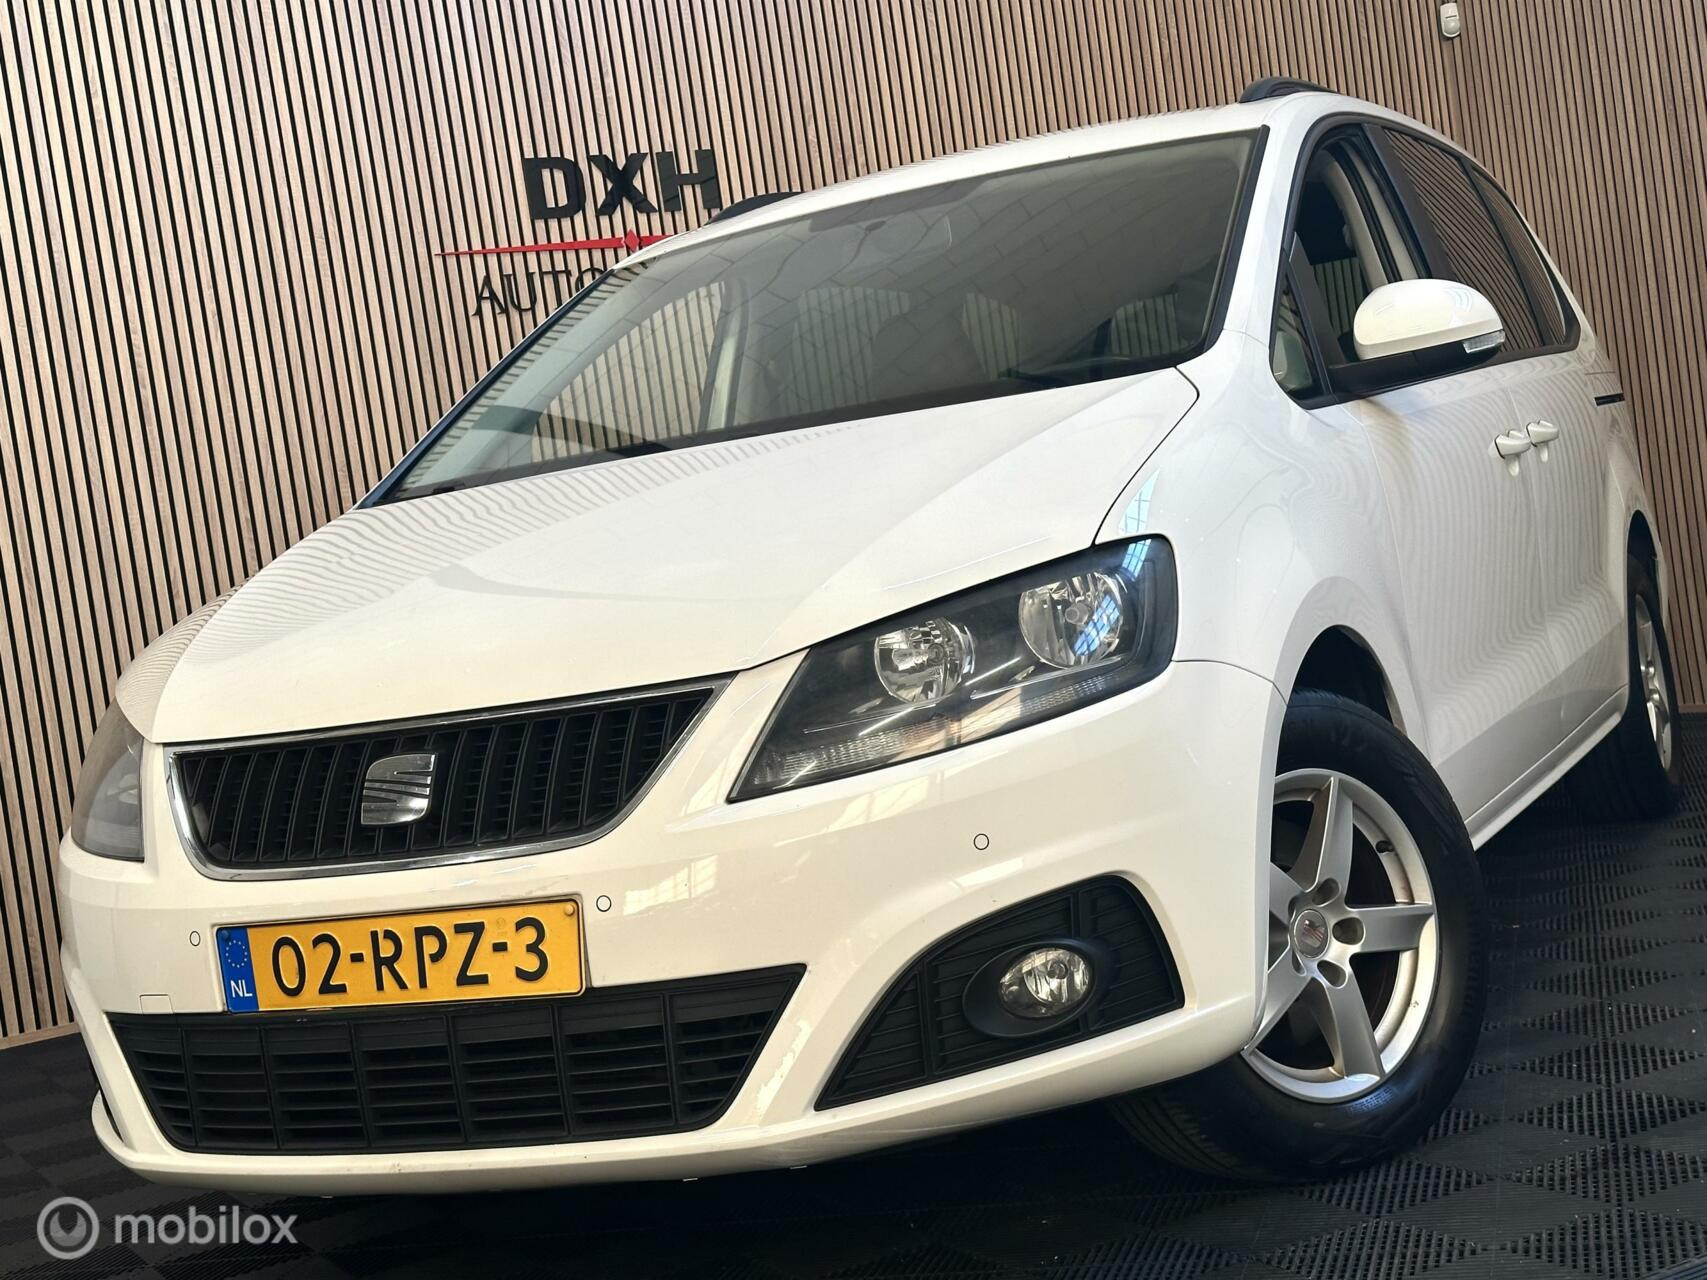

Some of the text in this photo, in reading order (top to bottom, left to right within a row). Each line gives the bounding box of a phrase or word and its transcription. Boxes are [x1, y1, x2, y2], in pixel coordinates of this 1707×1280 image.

[522, 150, 722, 219] DXH
[230, 980, 253, 998] NL
[271, 917, 549, 997] 02-RPZ-3
